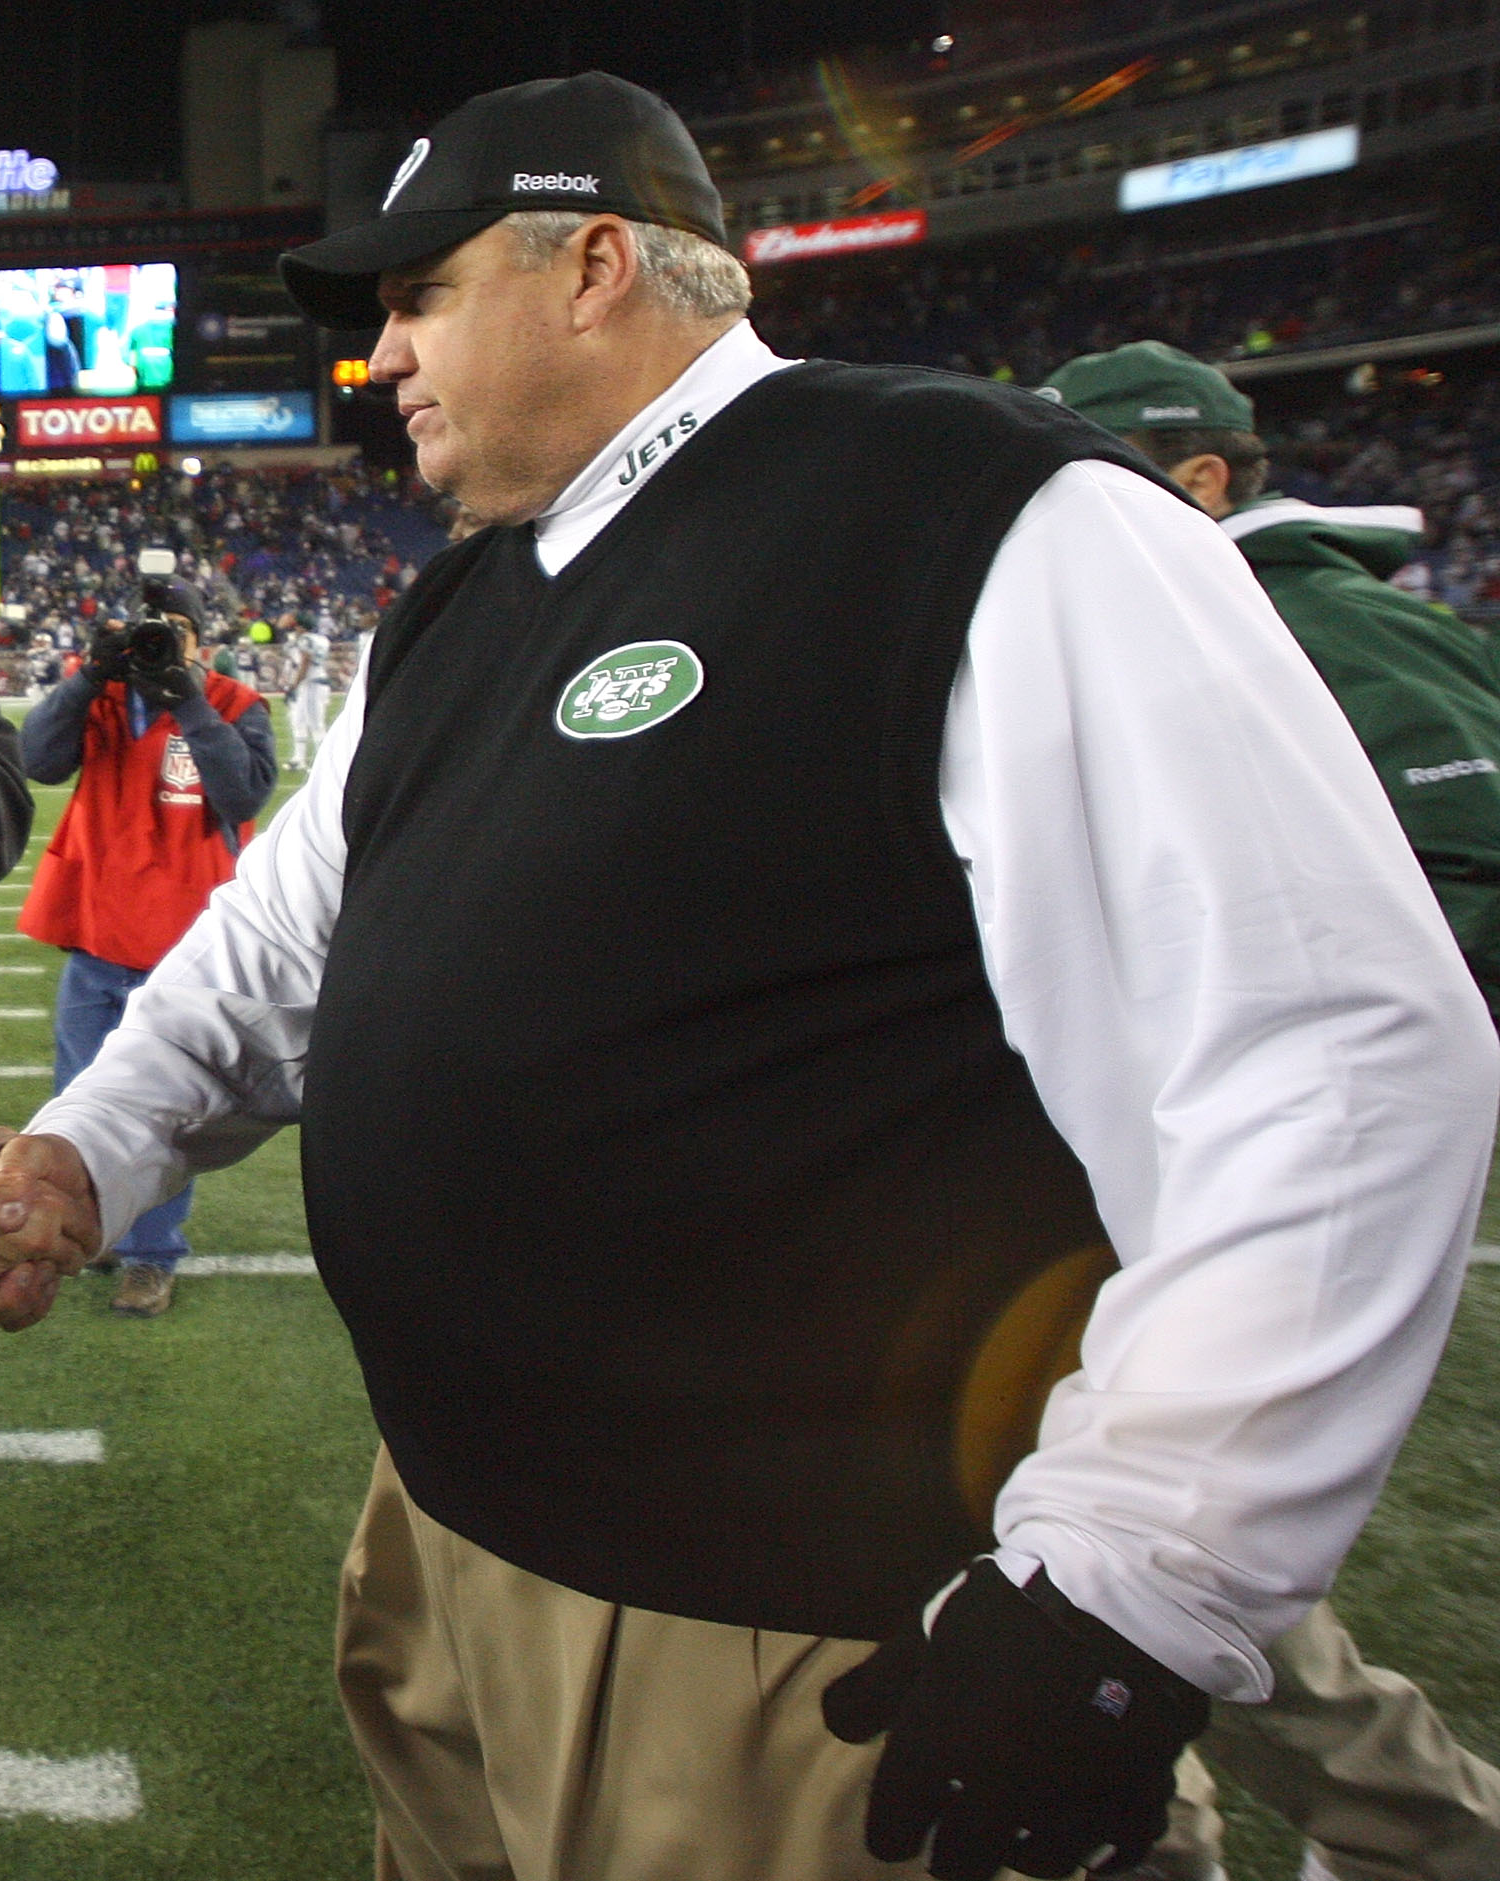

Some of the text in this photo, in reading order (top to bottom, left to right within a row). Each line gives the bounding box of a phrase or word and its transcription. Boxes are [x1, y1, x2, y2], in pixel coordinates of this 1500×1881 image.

[512, 171, 601, 194] Reebok
[21, 405, 158, 436] TOYOTA
[618, 411, 699, 486] JETS
[574, 672, 672, 703] JETS
